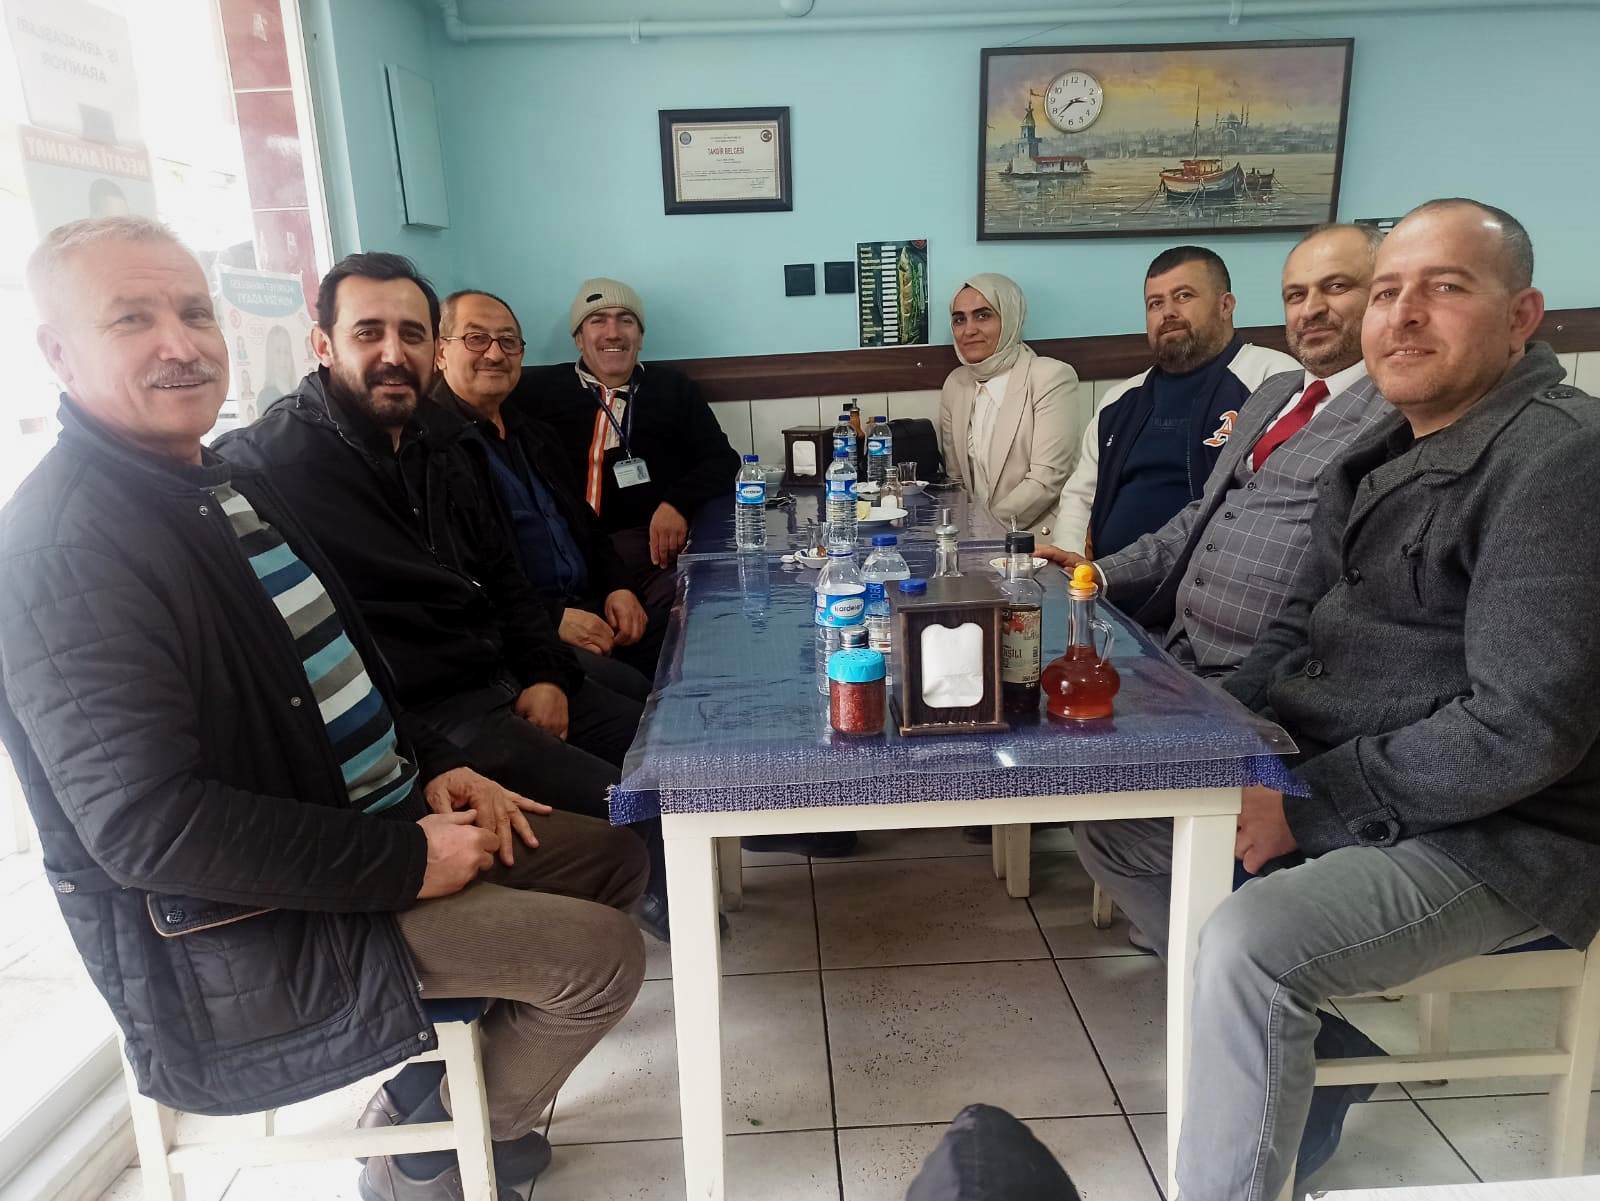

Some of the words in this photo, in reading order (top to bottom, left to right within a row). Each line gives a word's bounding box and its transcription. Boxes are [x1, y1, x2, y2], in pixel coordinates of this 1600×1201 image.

[1083, 79, 1087, 88] 1
[1088, 87, 1094, 96] 2
[1050, 97, 1056, 105] 9
[1090, 98, 1096, 106] 3
[1052, 107, 1058, 115] 8
[1085, 109, 1090, 117] 4
[1079, 116, 1084, 124] 5
